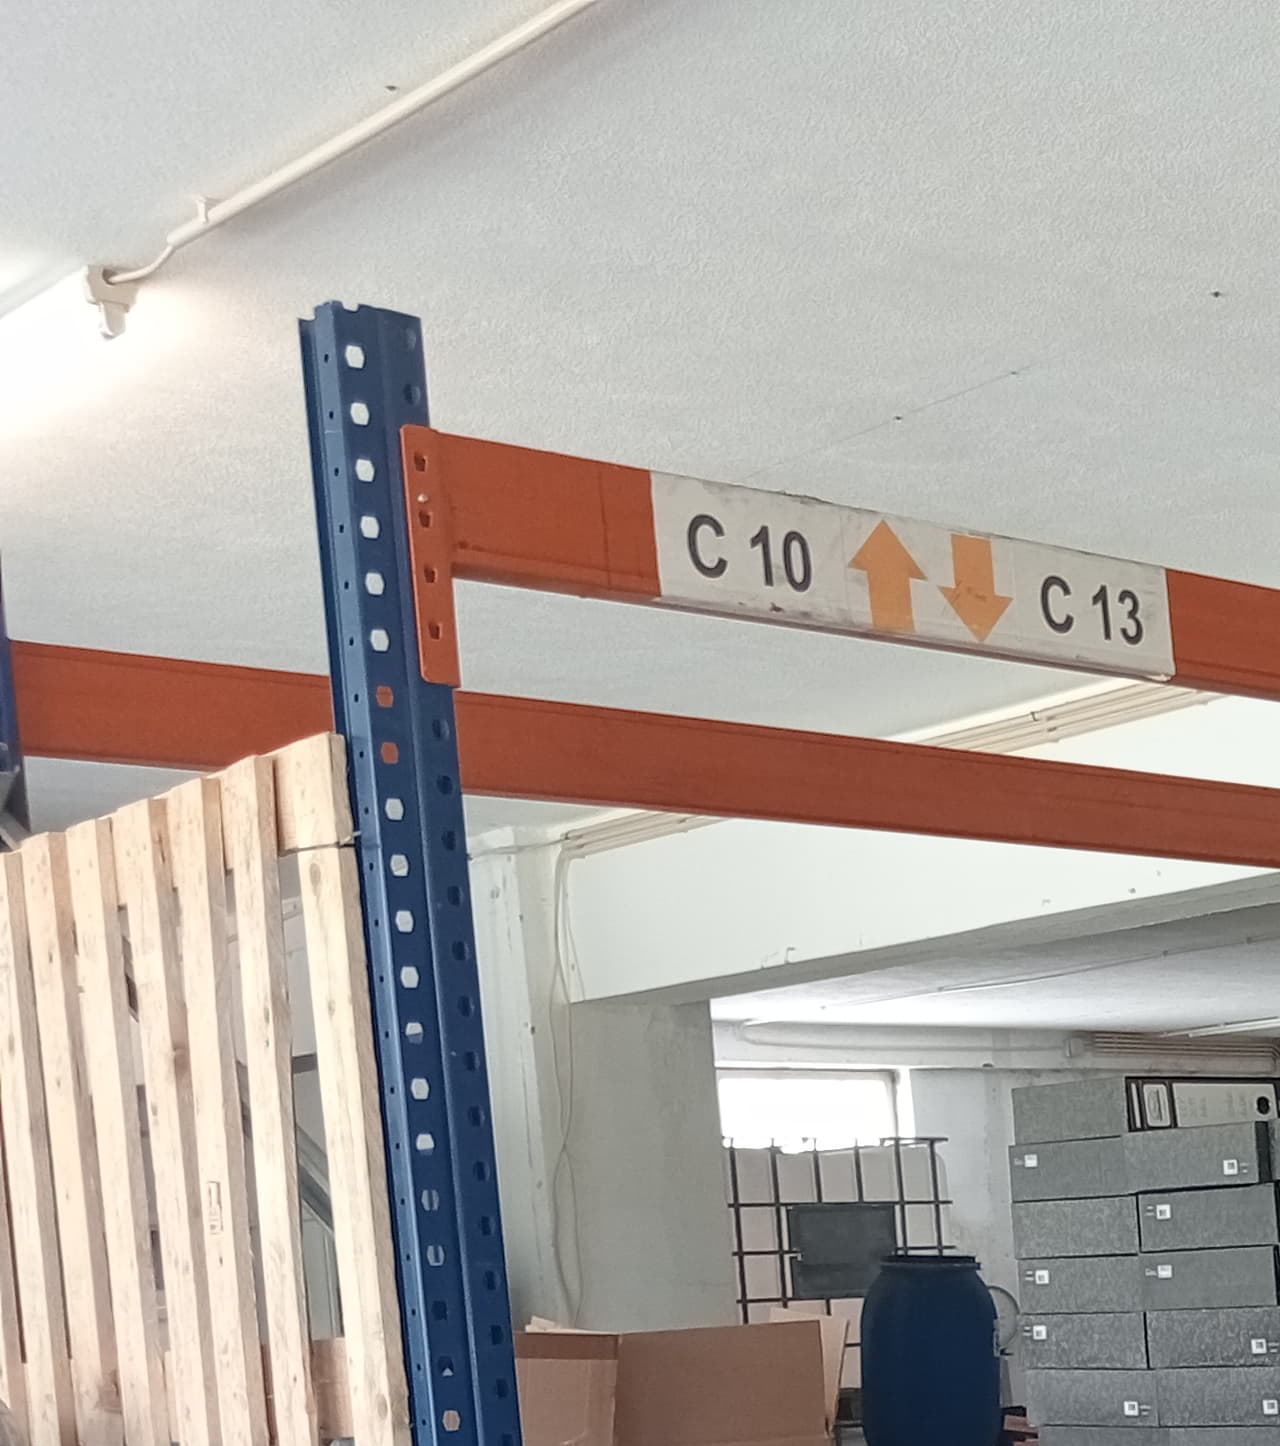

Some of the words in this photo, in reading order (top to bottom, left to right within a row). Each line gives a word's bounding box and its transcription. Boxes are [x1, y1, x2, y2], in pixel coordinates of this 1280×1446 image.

[686, 514, 729, 579] C
[749, 525, 813, 593] 10
[1039, 575, 1075, 634] C
[1091, 584, 1145, 646] 13
